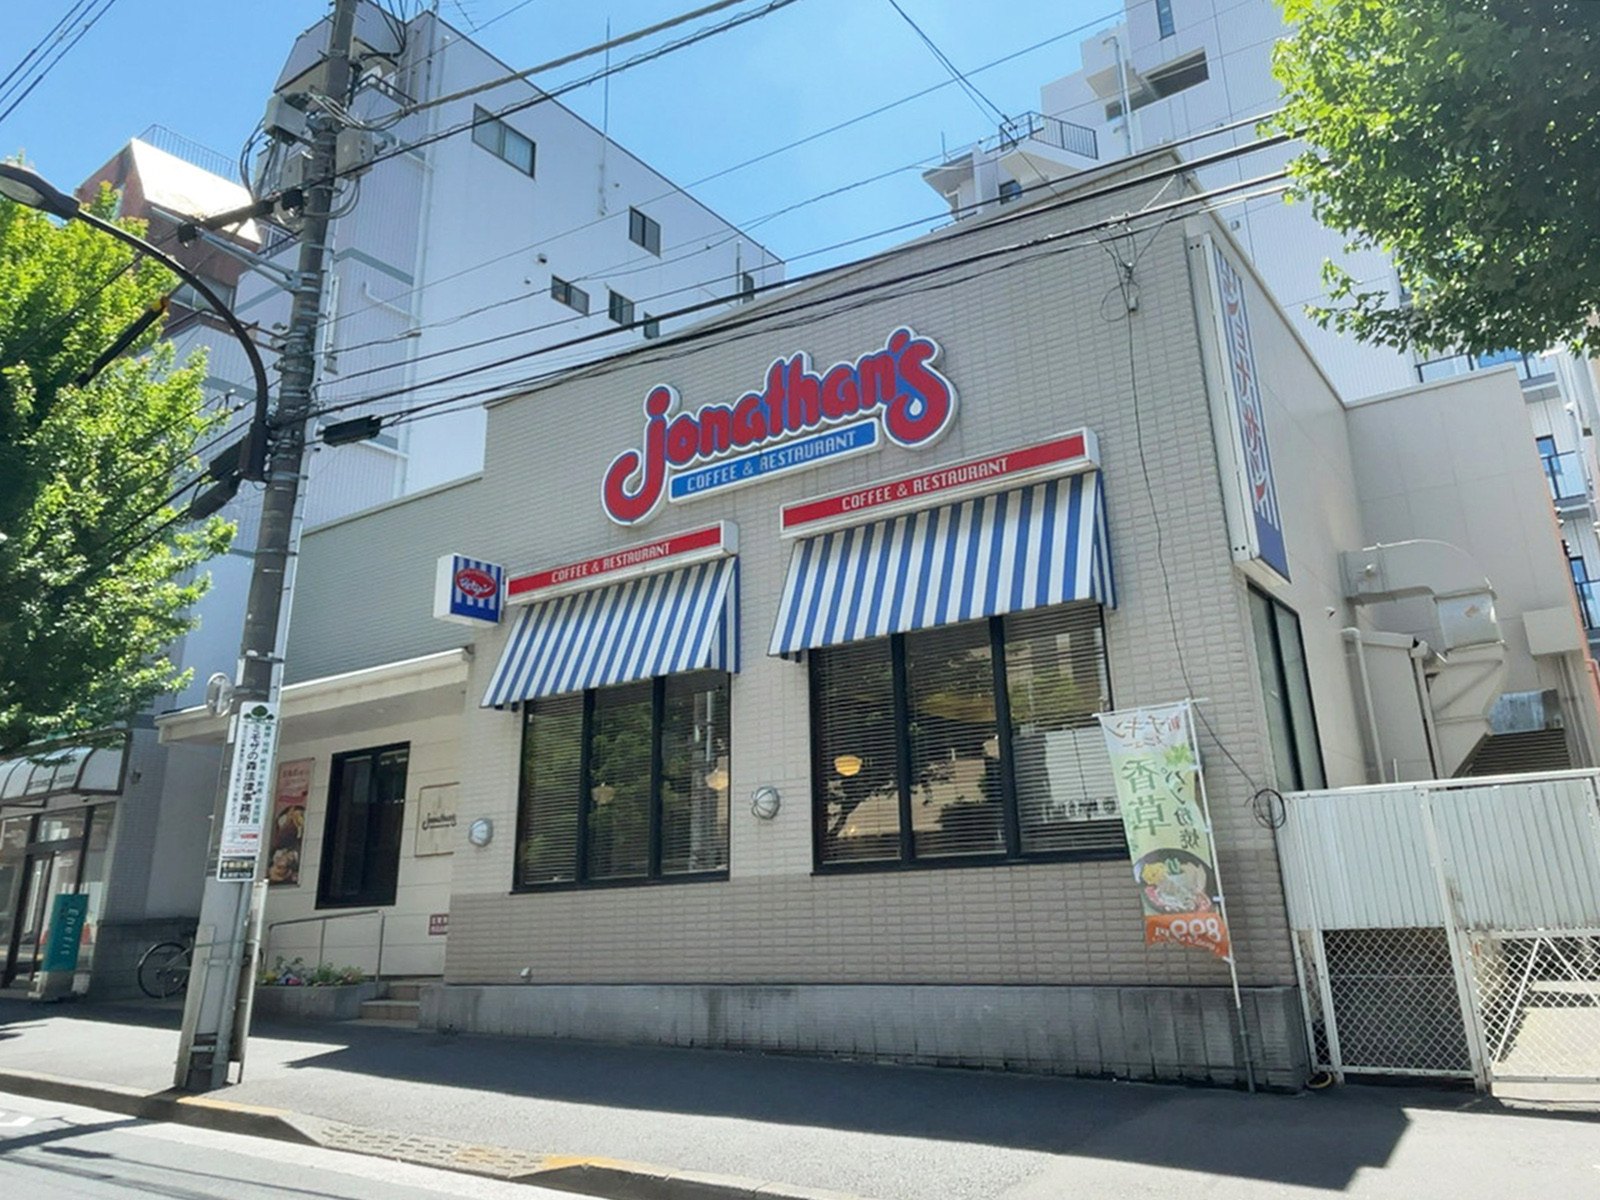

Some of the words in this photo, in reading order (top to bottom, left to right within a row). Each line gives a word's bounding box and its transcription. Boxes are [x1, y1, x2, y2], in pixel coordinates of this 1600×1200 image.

[686, 463, 738, 493] COFFEE
[742, 459, 754, 476] &
[758, 430, 857, 472] RESTAURANT
[841, 487, 893, 511] COFFEE
[896, 482, 909, 498] &
[912, 456, 1010, 495] RESTAURANT
[551, 565, 589, 584] COFFEE
[591, 562, 600, 574] &
[602, 542, 671, 570] RESTAURANT
